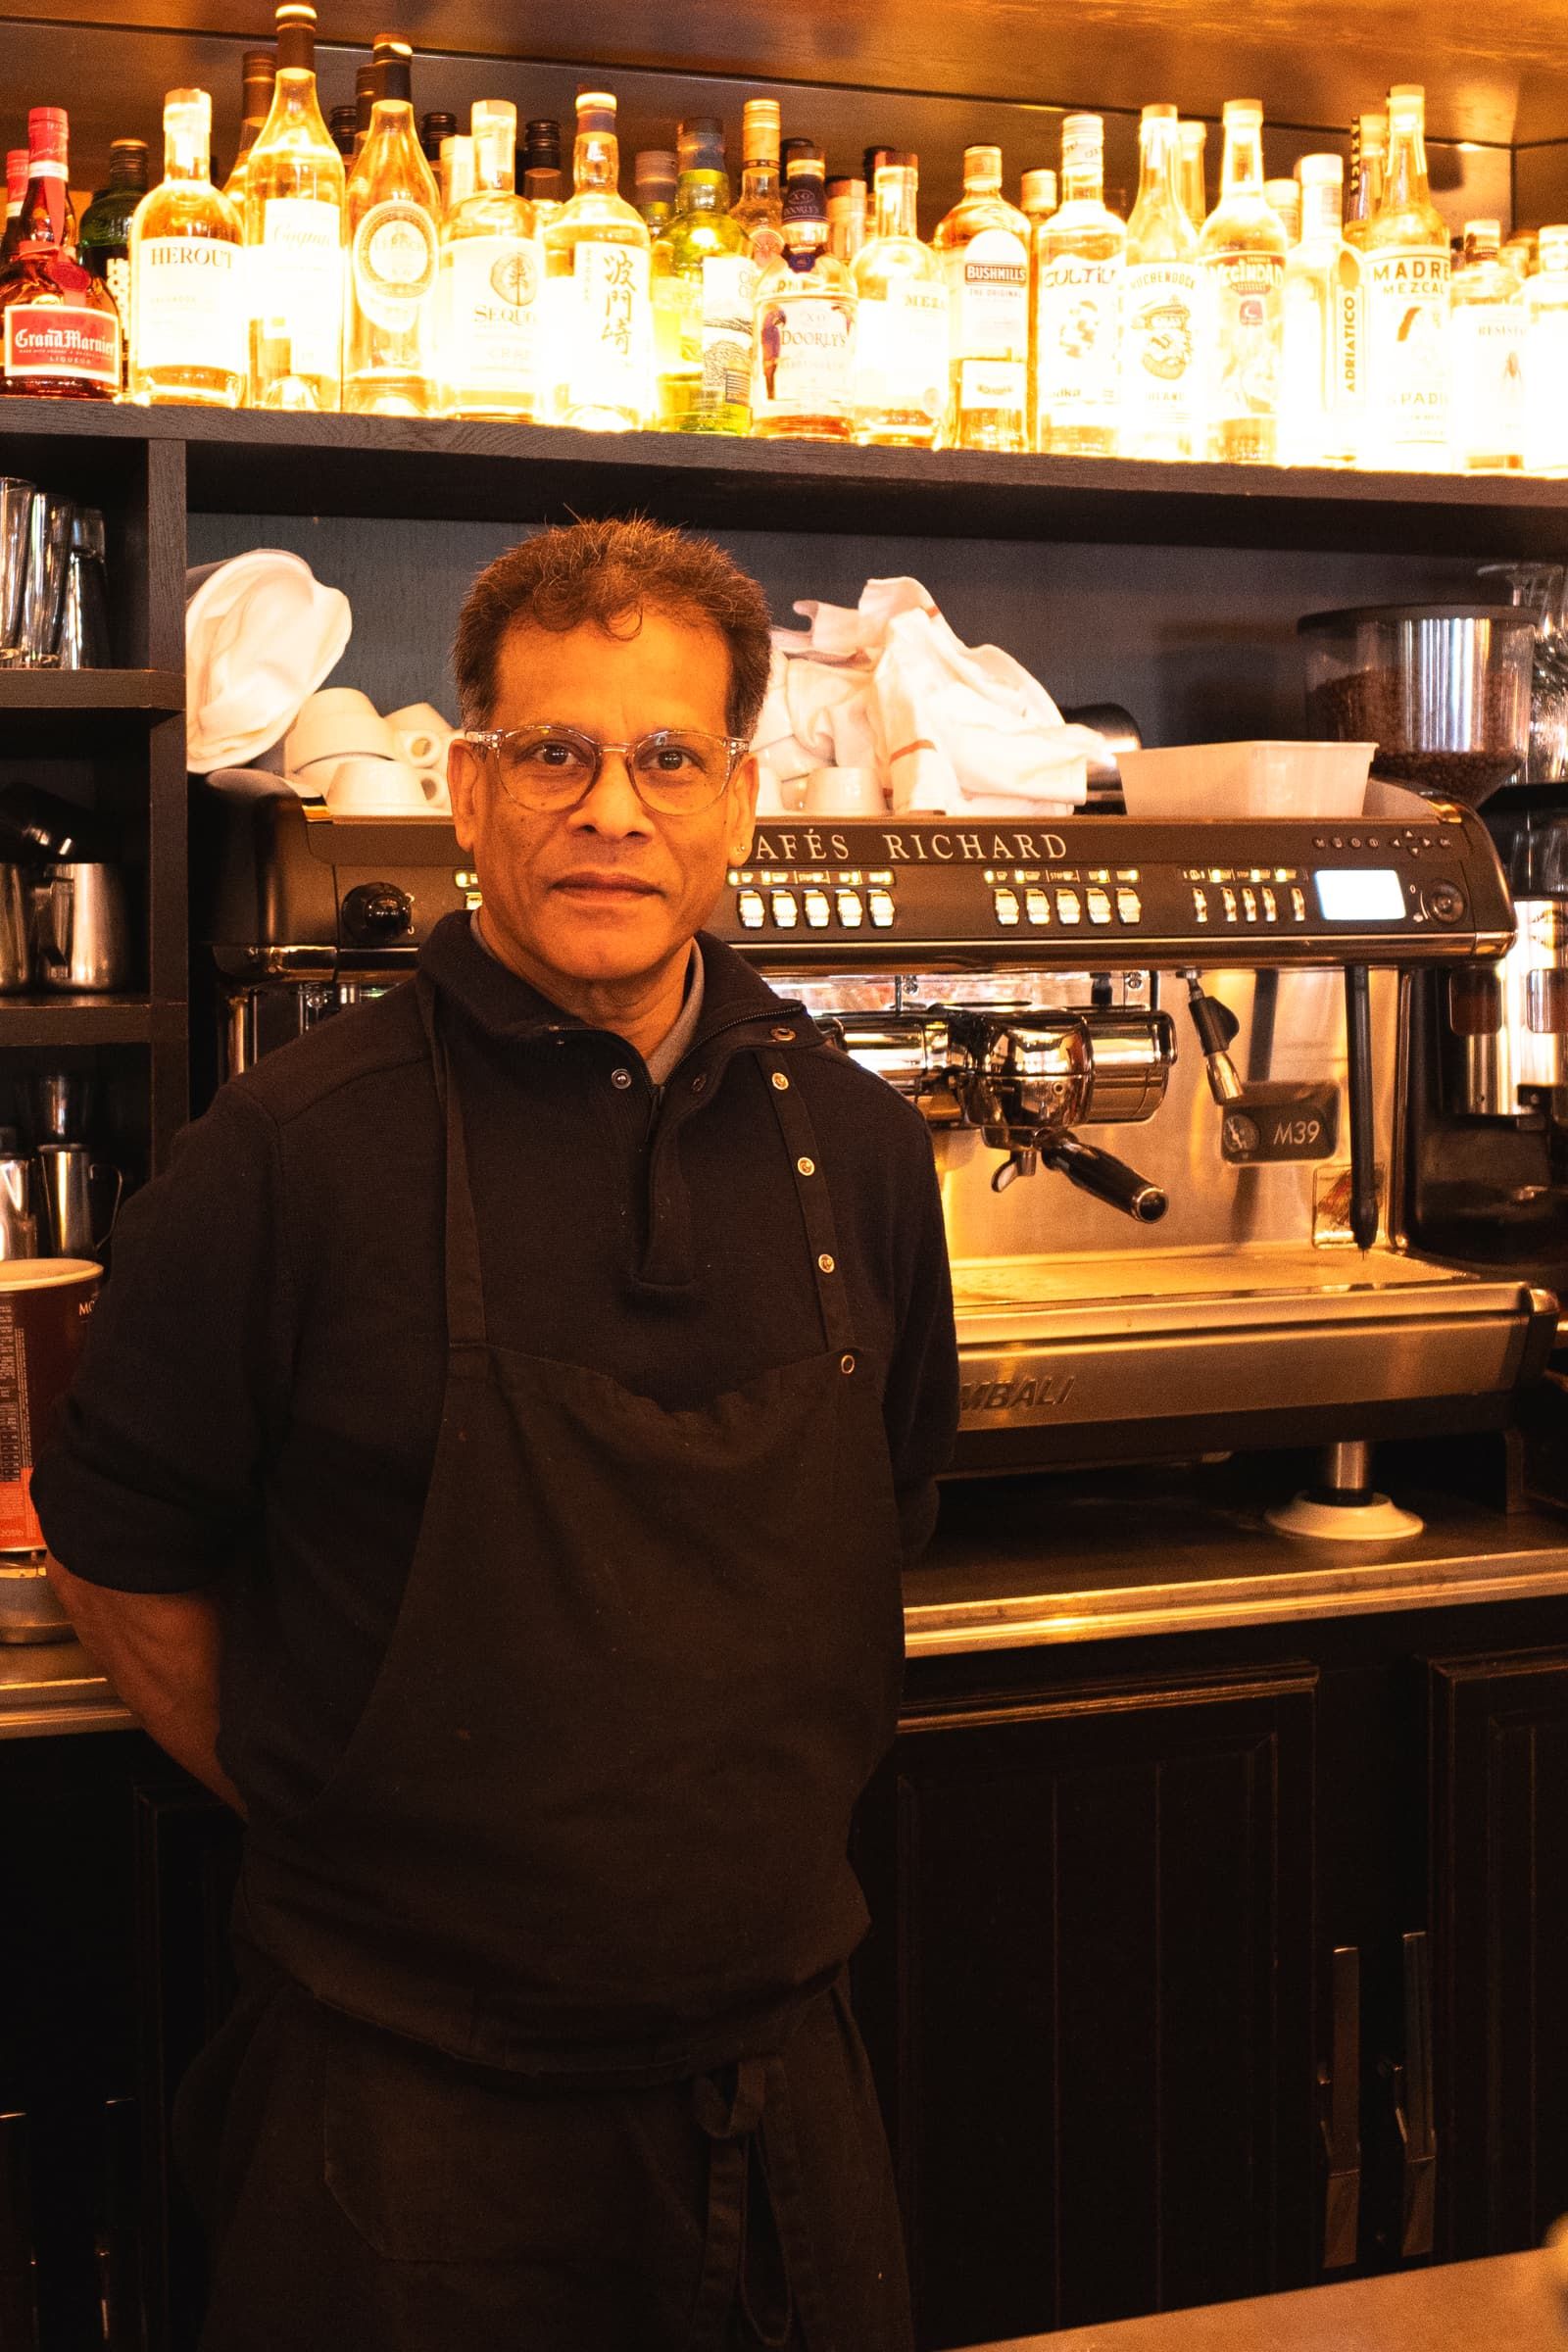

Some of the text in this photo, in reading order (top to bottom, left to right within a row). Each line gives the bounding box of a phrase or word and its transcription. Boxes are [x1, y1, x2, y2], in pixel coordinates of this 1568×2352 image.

[151, 247, 231, 269] HEROUT
[966, 266, 1027, 281] BUSHMILLS
[1373, 261, 1449, 281] MADRE
[1383, 282, 1445, 296] MEZCAL
[1344, 296, 1355, 393] ADRIATICO
[756, 829, 1067, 859] AFÉS RICHARD
[1274, 1120, 1321, 1145] M39
[961, 1376, 1075, 1410] MBALI
